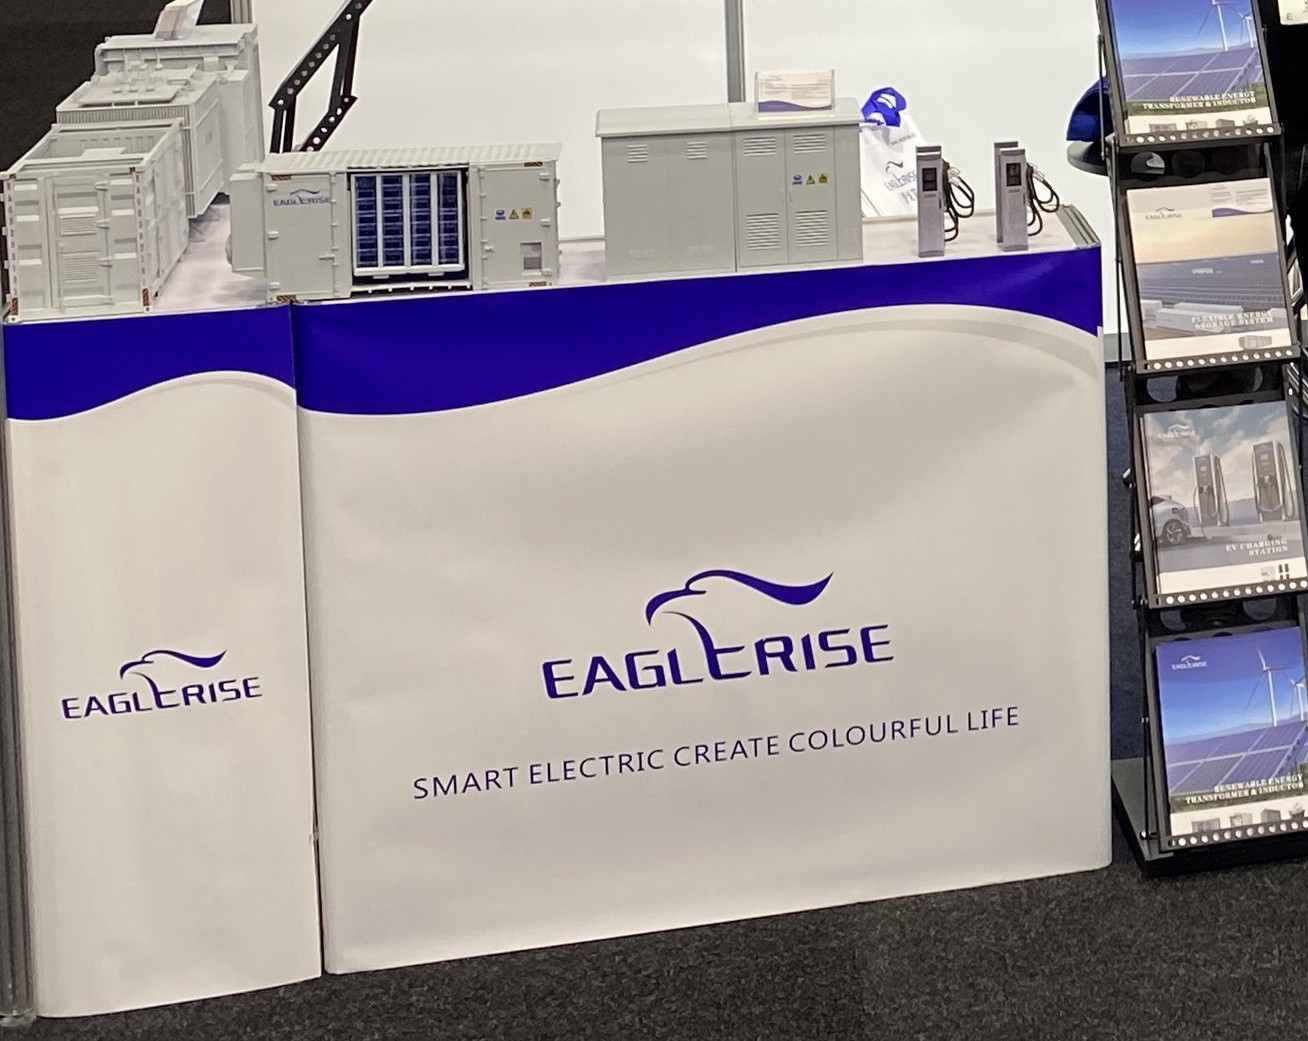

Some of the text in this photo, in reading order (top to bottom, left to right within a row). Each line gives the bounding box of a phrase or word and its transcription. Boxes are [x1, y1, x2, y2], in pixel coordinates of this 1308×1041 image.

[61, 674, 262, 721] EAGLERISE
[542, 621, 894, 700] EAGLERISE
[411, 704, 1022, 800] SMART ELECTRIC CREATE COLOURFUL LIFE
